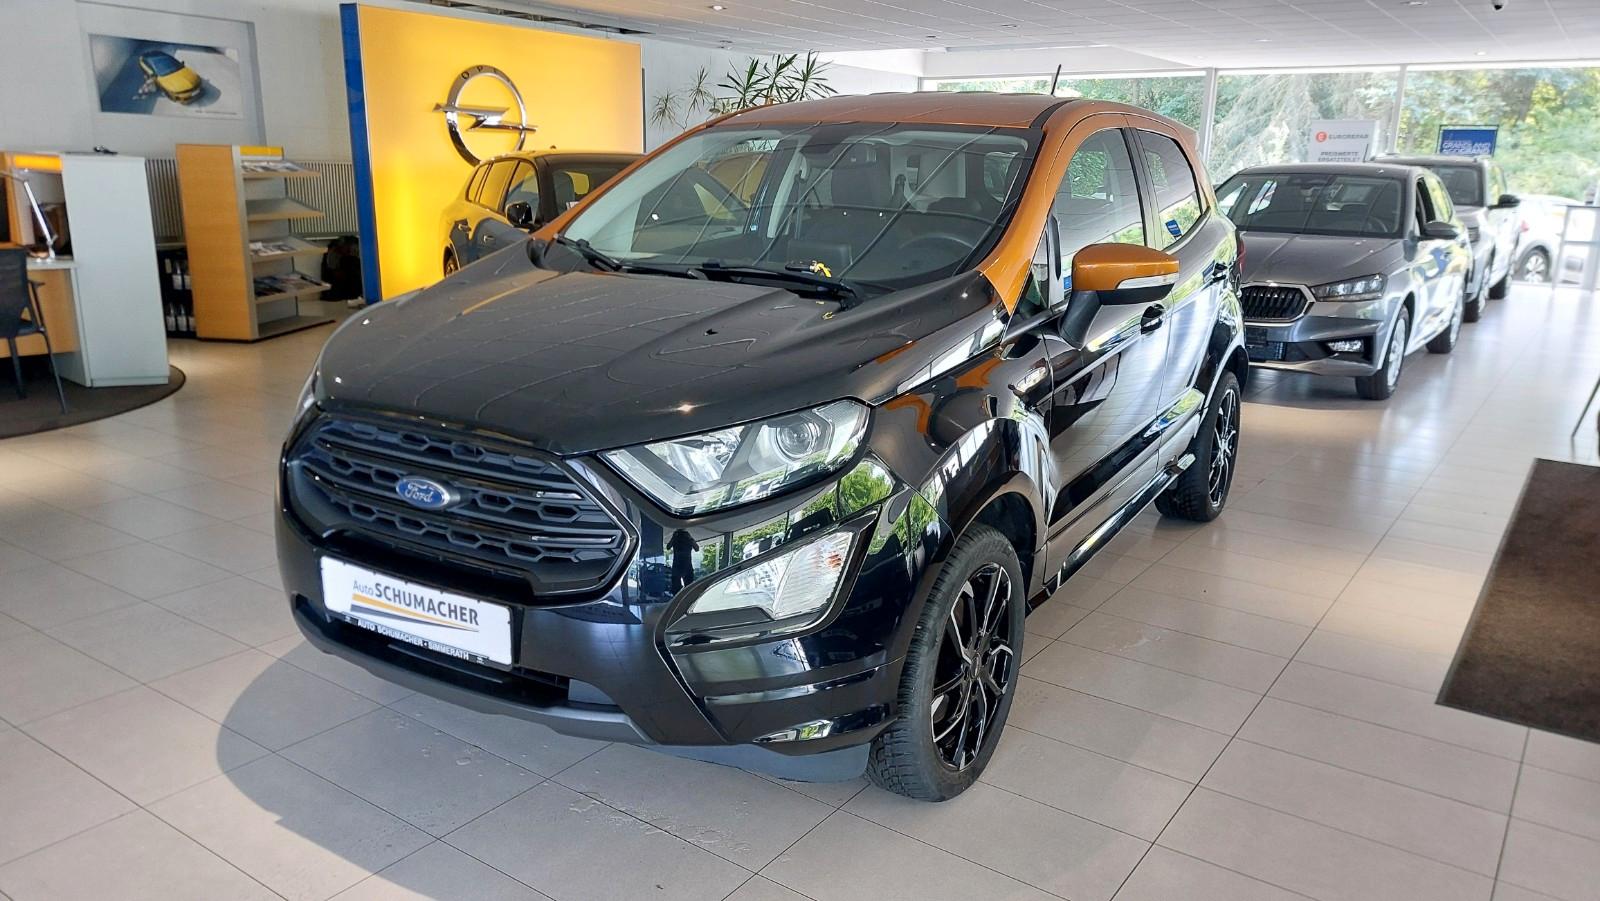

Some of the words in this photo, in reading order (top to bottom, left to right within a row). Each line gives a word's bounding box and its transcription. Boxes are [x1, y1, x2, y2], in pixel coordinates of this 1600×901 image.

[404, 482, 434, 502] Ford
[353, 580, 374, 596] Auto
[375, 583, 479, 626] SCHUMACHER
[358, 619, 376, 631] AUTO
[377, 625, 424, 647] SCHUMACHER
[428, 641, 470, 661] SIMMERATH
